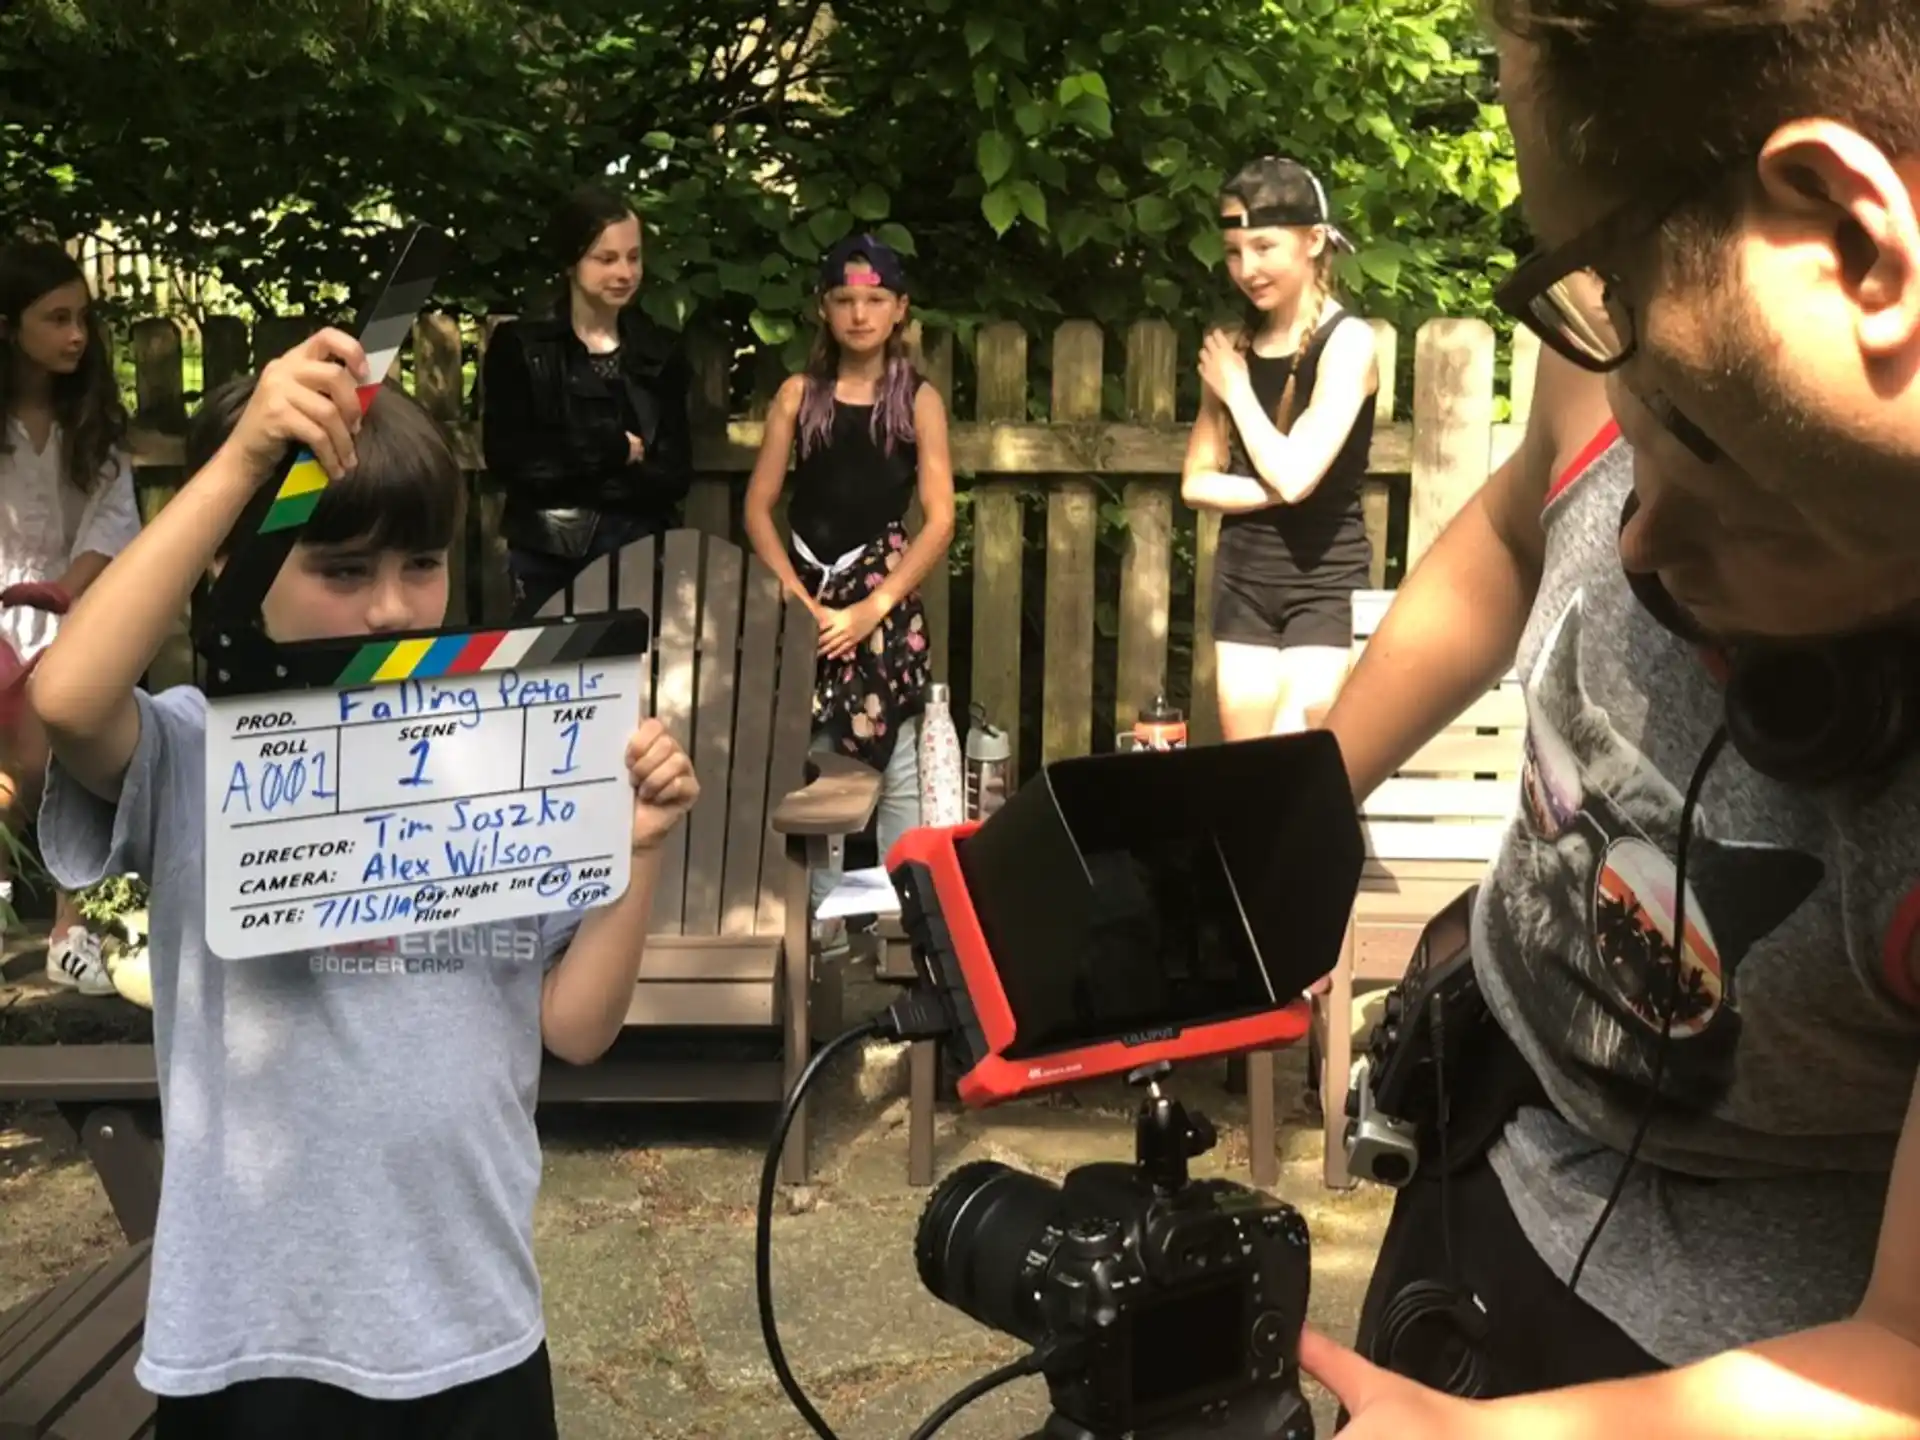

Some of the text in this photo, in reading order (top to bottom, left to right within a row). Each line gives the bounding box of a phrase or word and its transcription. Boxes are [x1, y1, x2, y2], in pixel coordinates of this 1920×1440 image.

[338, 662, 605, 728] Falling Petals
[236, 711, 297, 731] PROD.
[552, 706, 597, 723] TAKE
[398, 722, 457, 742] SCENE
[260, 739, 308, 758] ROLL
[551, 721, 581, 775] 1
[398, 738, 433, 786] 1
[364, 788, 577, 848] Tim Soszko
[239, 839, 356, 869] DIRECTOR:
[362, 831, 553, 884] Alex Wilson
[239, 870, 338, 895] CAMERA:
[509, 876, 535, 890] Int
[240, 907, 305, 930] DATE:
[414, 908, 461, 924] Filter
[401, 927, 539, 961] EAGLES
